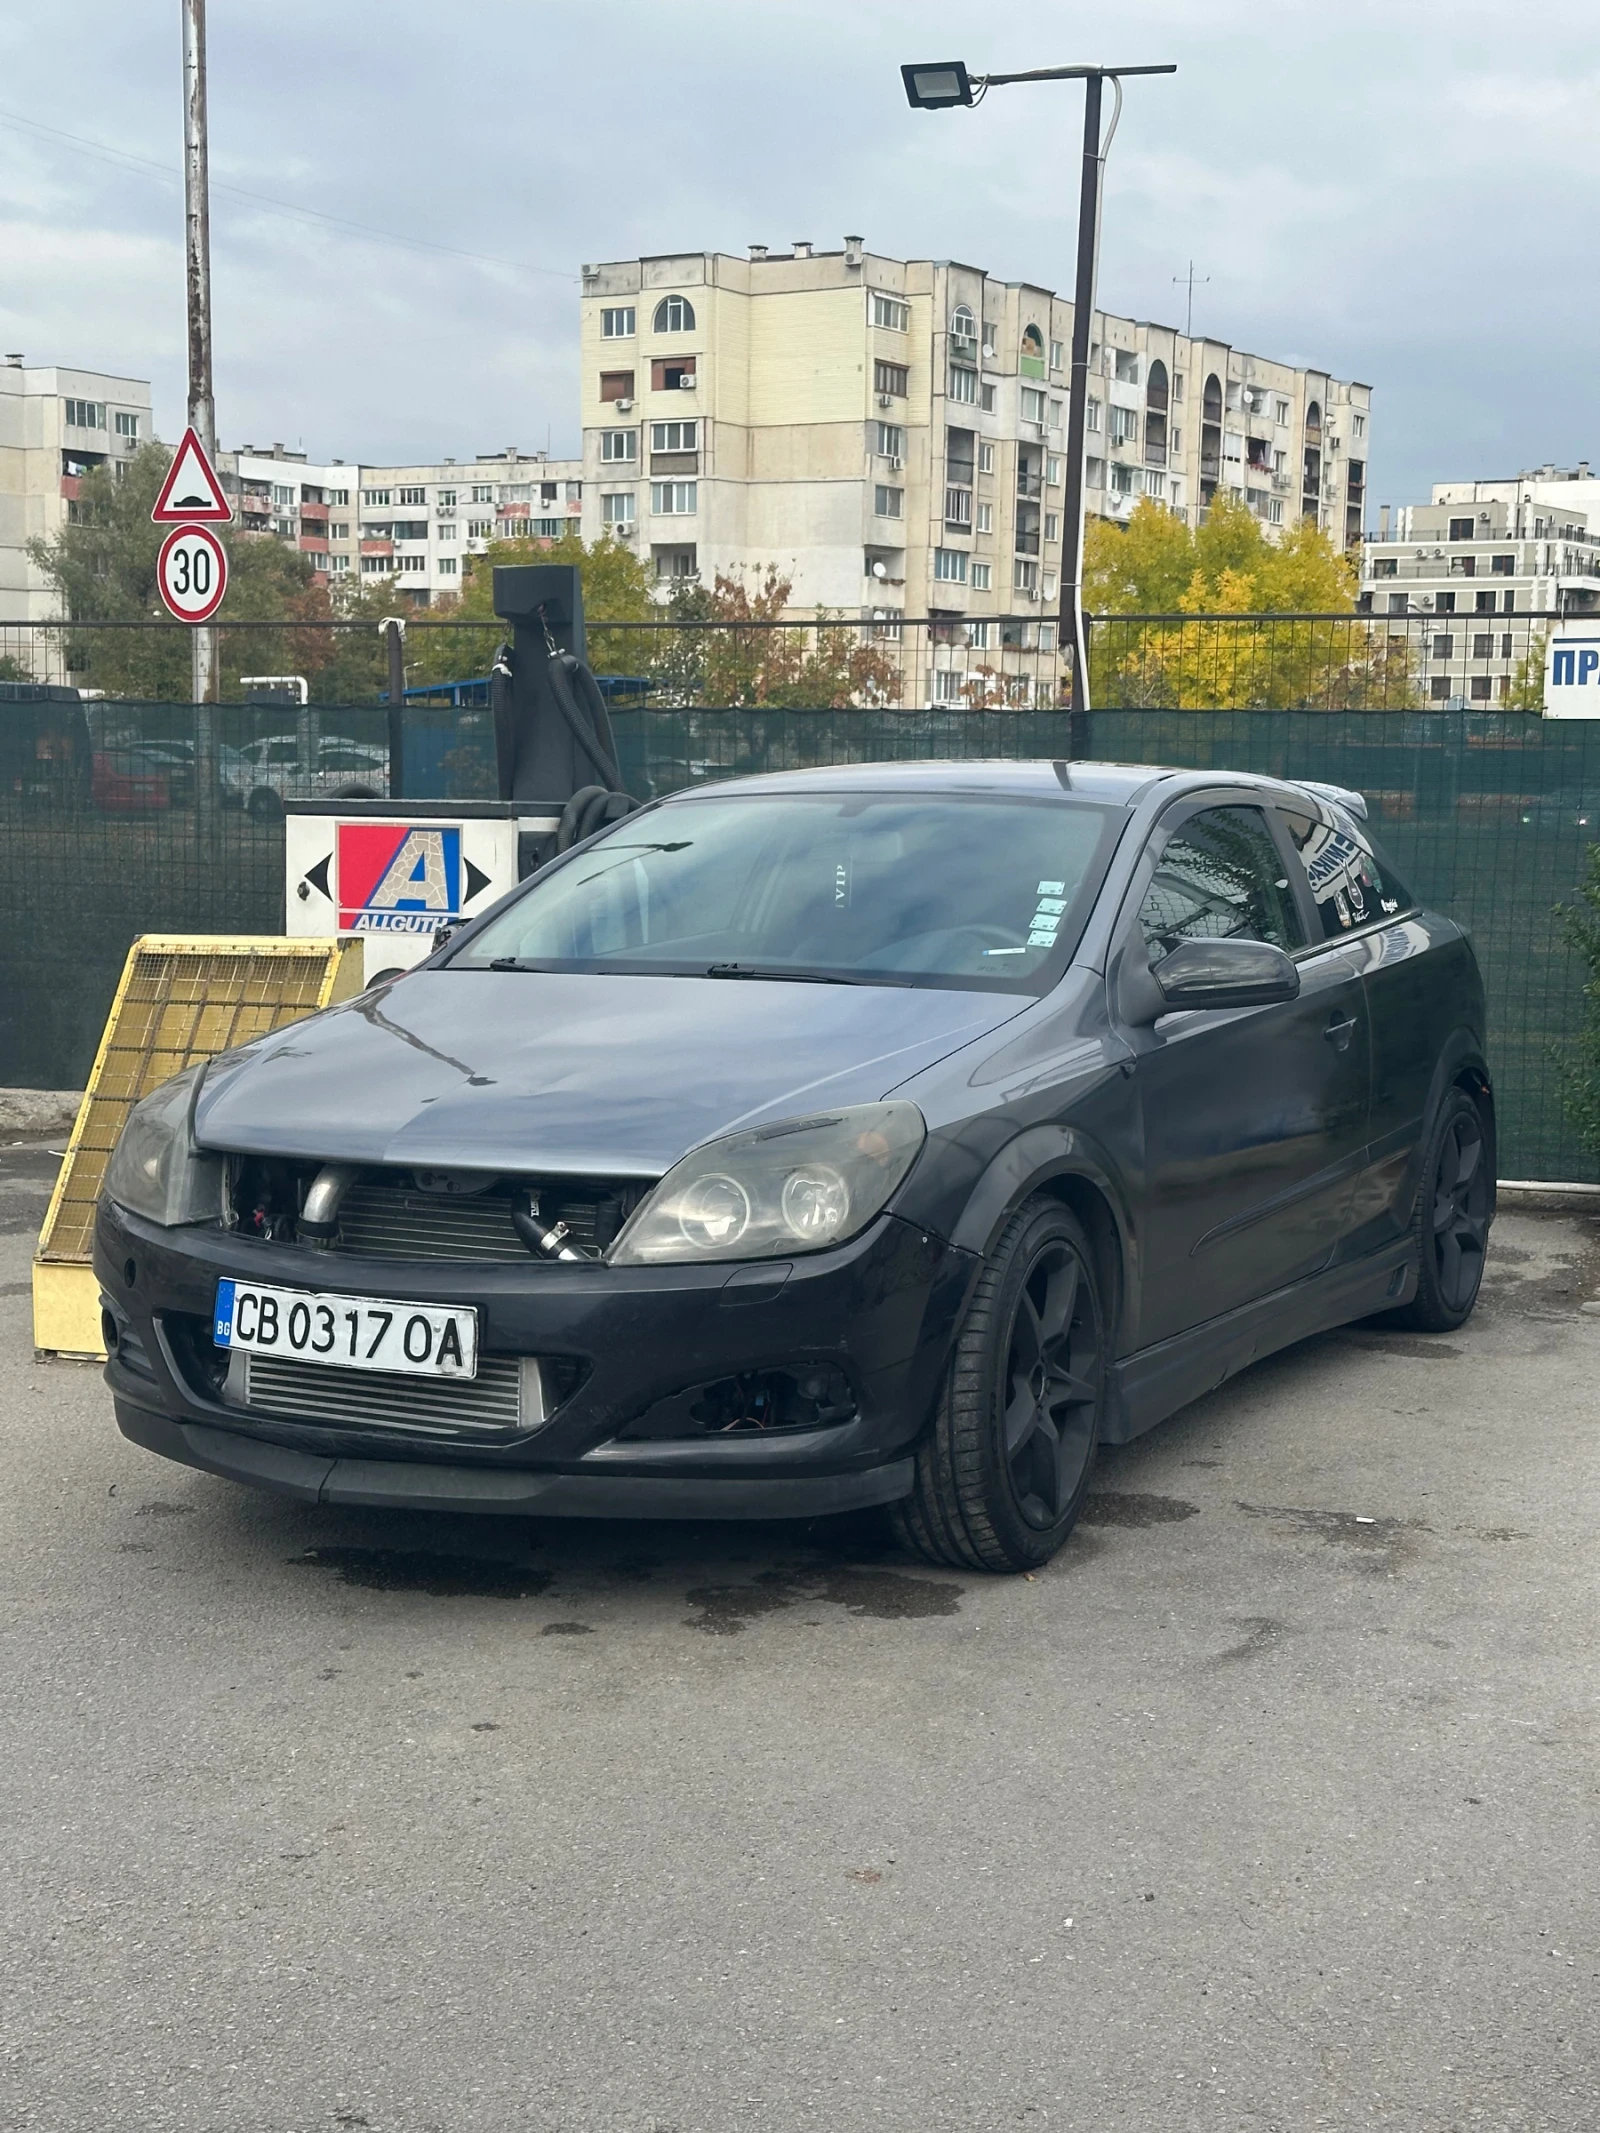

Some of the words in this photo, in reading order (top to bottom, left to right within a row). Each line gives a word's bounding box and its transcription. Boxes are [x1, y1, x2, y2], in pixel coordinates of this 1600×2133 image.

[174, 548, 210, 595] 30
[1552, 650, 1600, 686] ПР
[354, 914, 448, 932] ALLGUTH
[216, 1322, 231, 1337] BG
